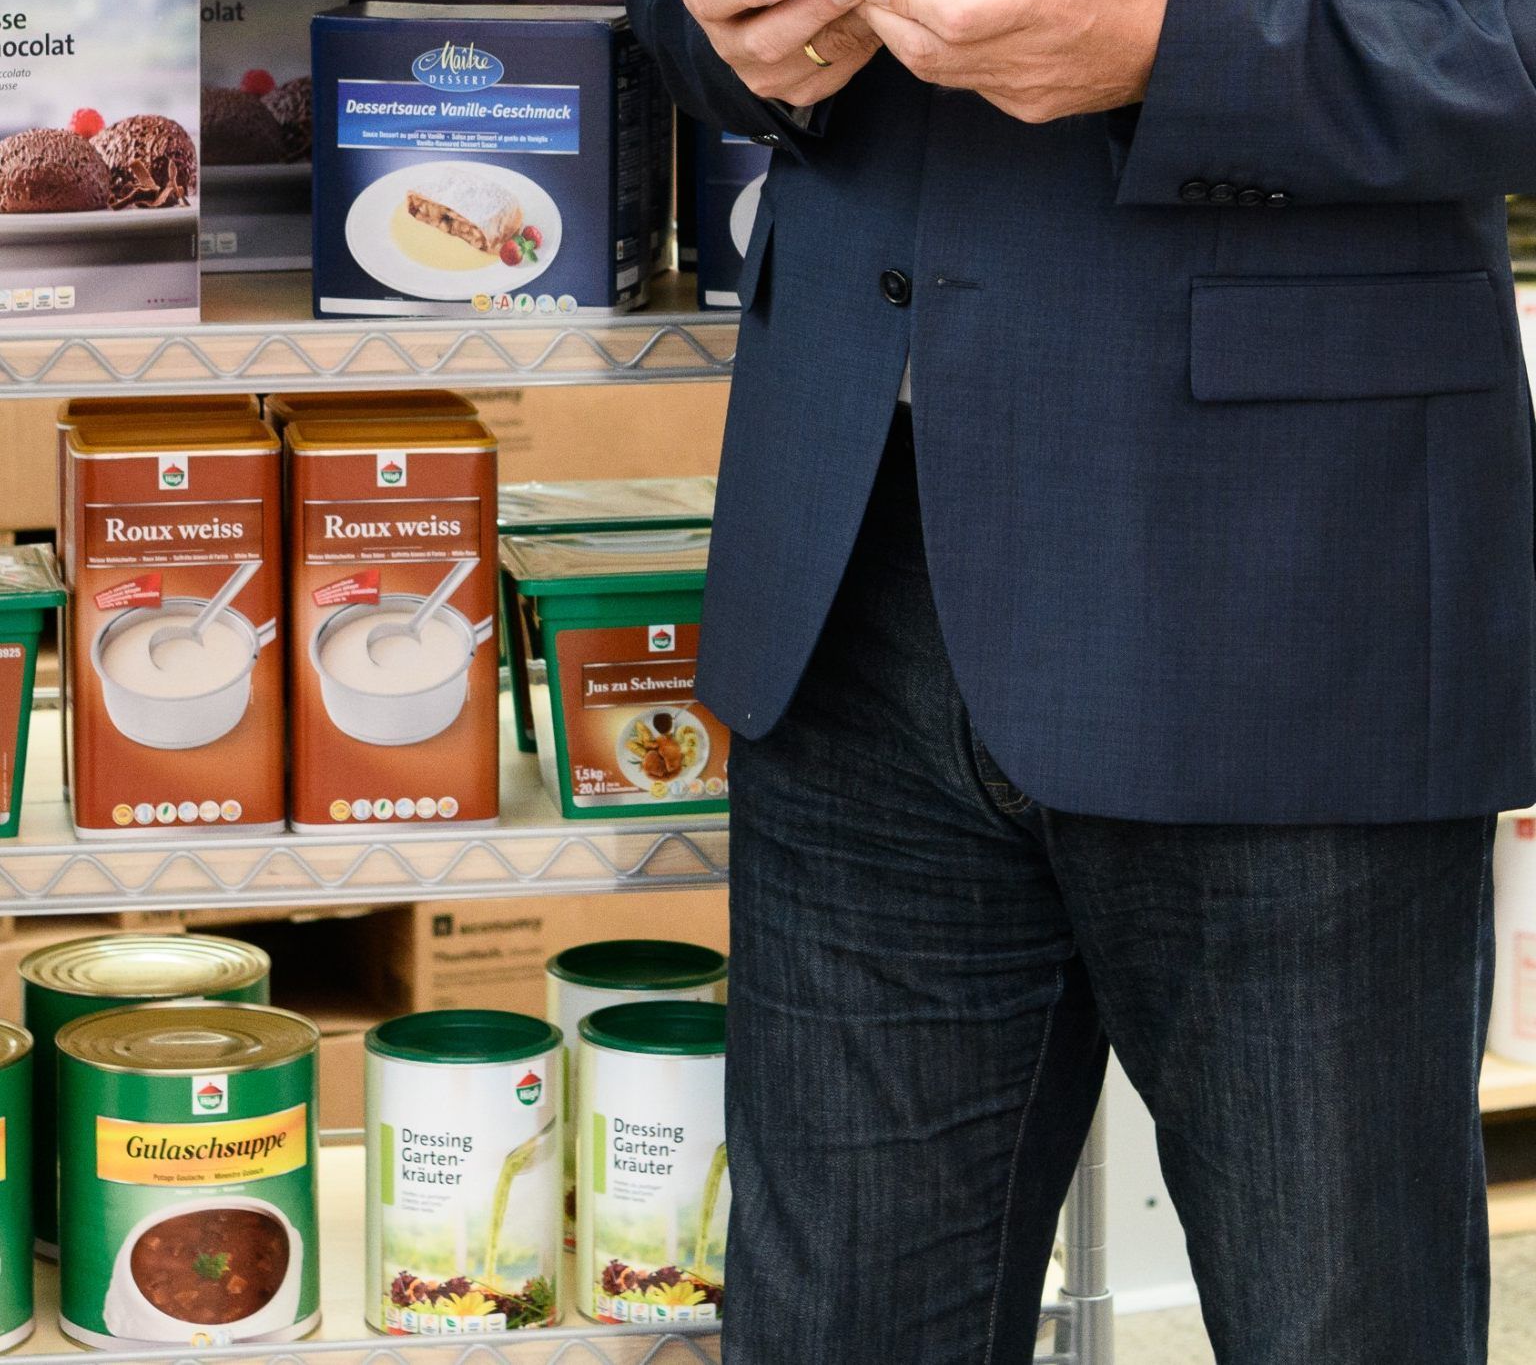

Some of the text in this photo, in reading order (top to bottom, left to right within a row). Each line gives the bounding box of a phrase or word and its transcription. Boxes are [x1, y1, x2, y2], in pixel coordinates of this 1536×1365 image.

[0, 13, 27, 30] se
[0, 33, 75, 58] ocolat
[429, 74, 488, 85] DESSERT
[346, 99, 572, 120] Dessertsauce Vanille-Geschmack
[105, 517, 244, 542] Roux weiss
[324, 515, 461, 539] Roux weiss
[586, 675, 696, 696] Jus zu Schweine
[402, 1128, 473, 1153] Dressing
[614, 1118, 684, 1144] Dressing
[126, 1131, 286, 1160] Gulaschsuppe
[614, 1137, 677, 1157] Garten-
[402, 1147, 465, 1166] Garten-
[614, 1153, 673, 1175] kräuter
[402, 1164, 462, 1185] kräuter
